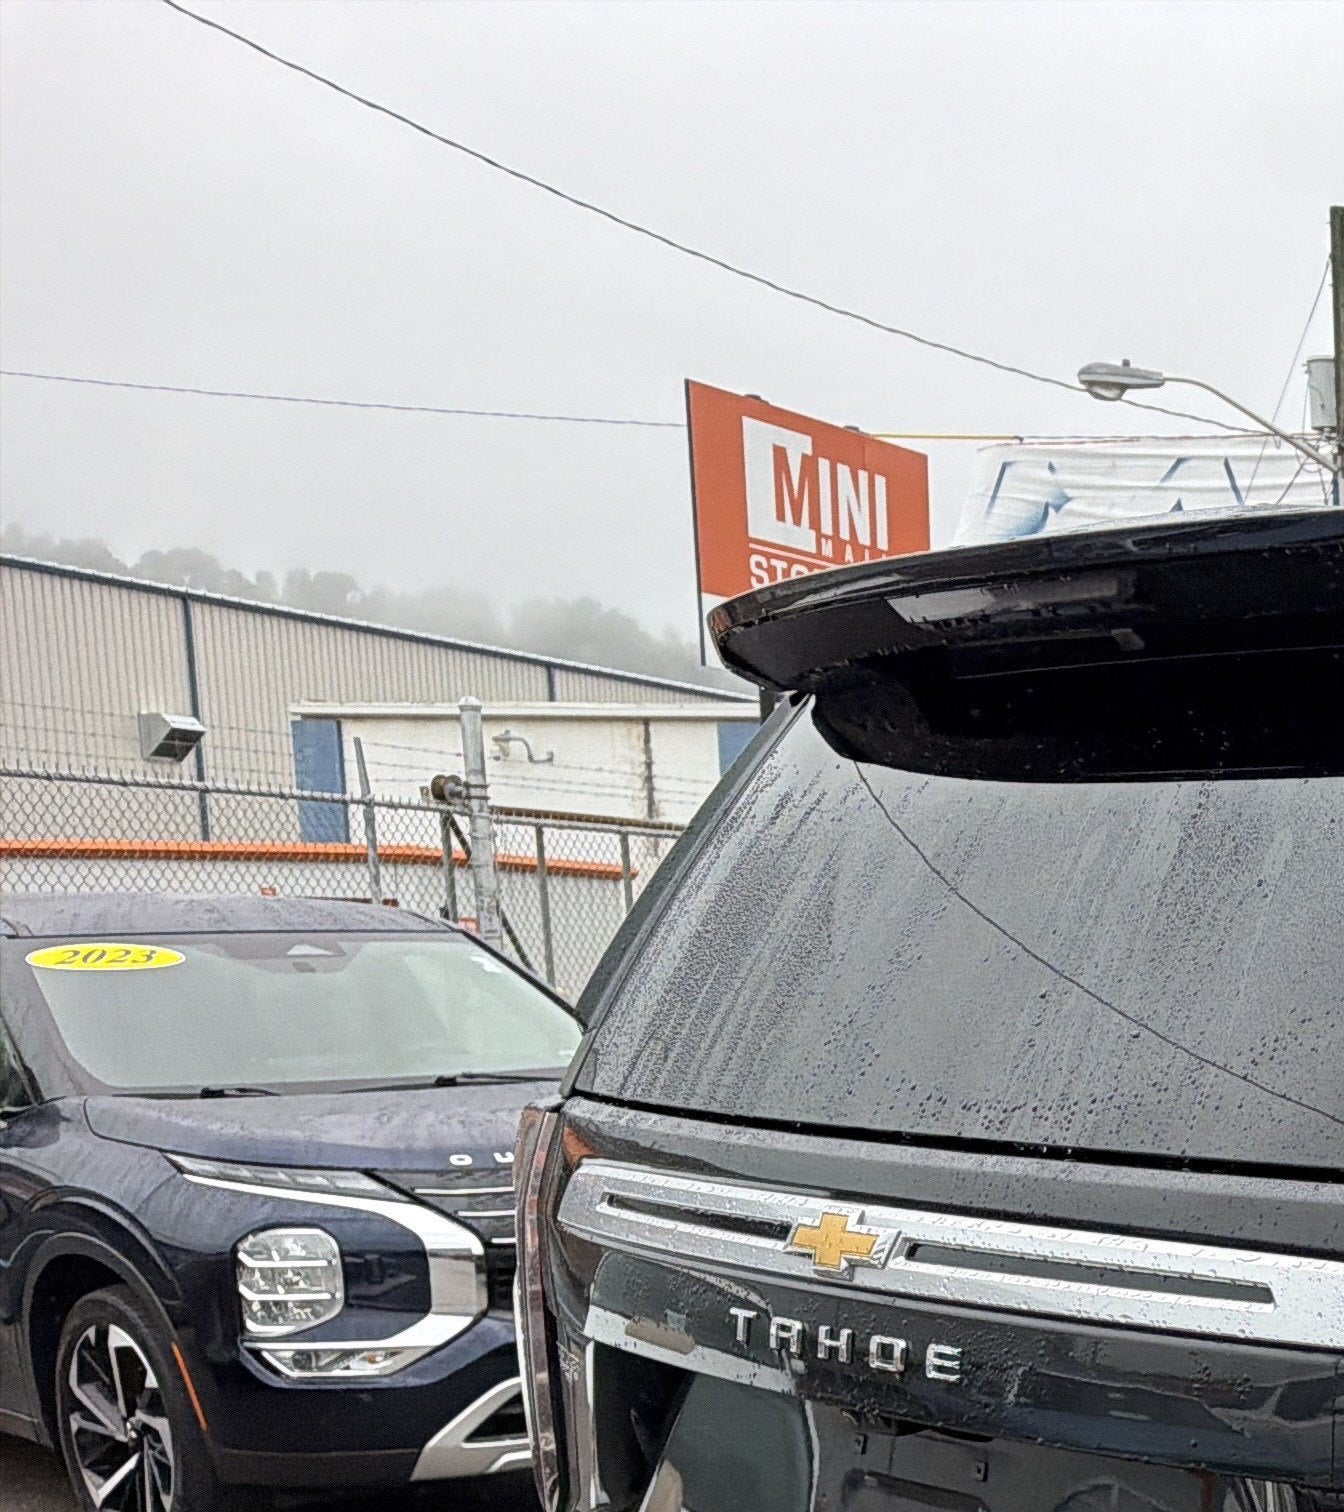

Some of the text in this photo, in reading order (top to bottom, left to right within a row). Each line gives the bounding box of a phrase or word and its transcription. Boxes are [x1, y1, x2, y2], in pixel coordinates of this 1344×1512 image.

[742, 415, 889, 554] MINI
[54, 948, 158, 966] 2023
[729, 1306, 963, 1383] TAHOE
